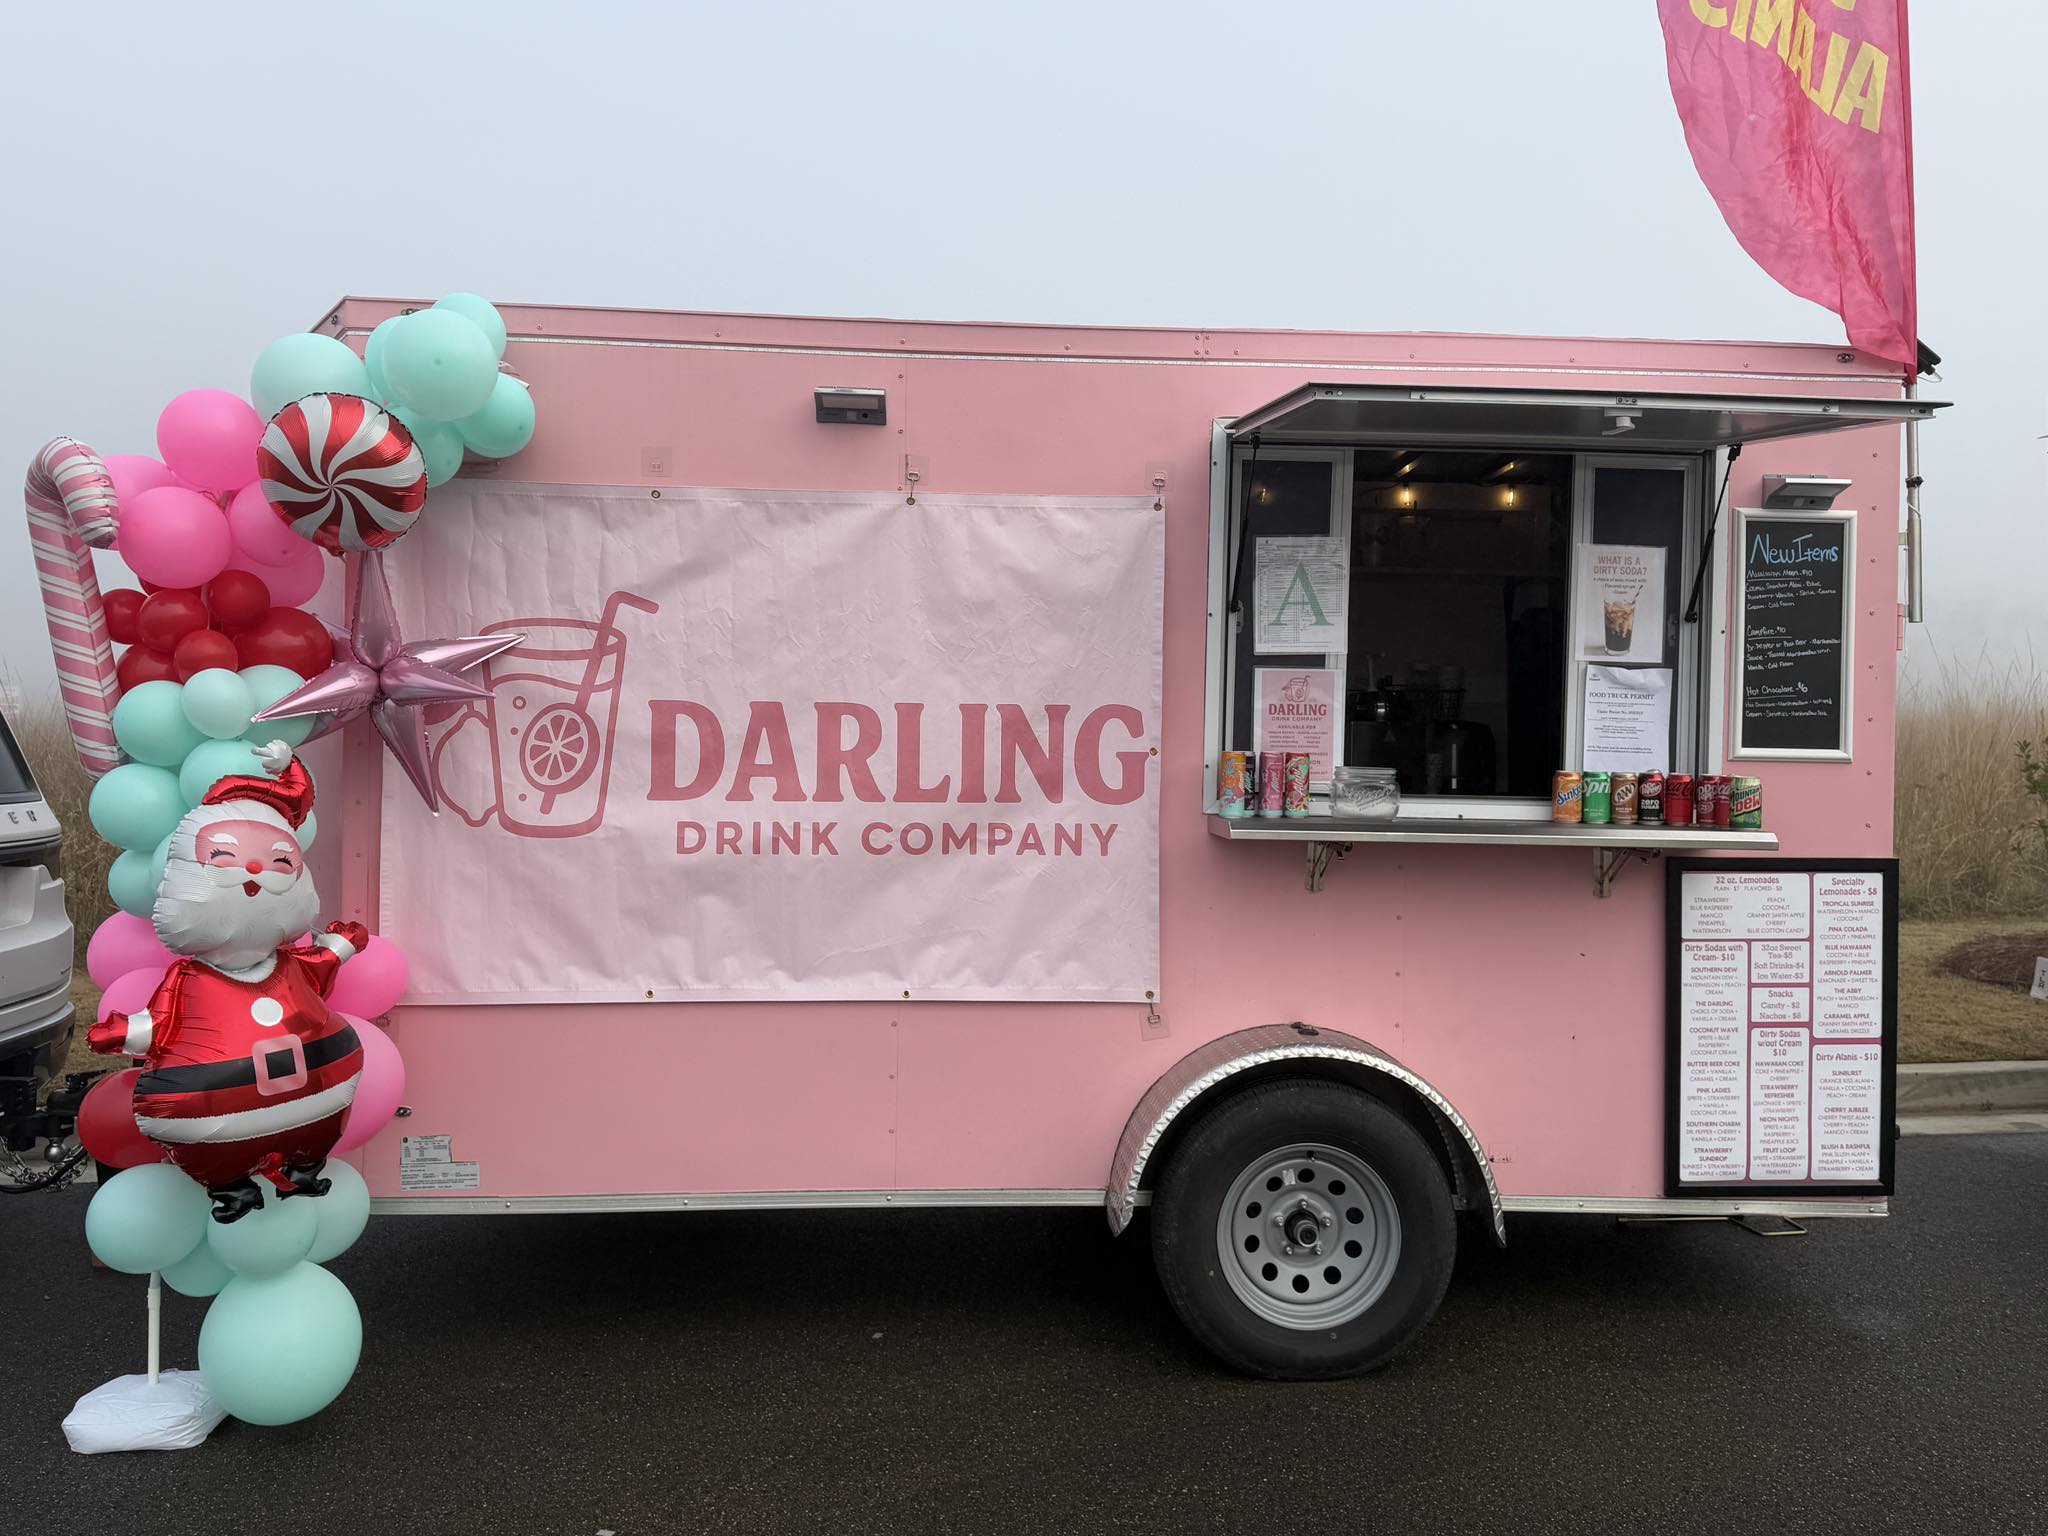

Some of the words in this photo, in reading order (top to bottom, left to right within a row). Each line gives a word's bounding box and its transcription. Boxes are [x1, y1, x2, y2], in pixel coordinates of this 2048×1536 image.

[1599, 556, 1622, 564] WHAT
[1625, 557, 1632, 565] IS
[1635, 557, 1640, 565] A
[1594, 566, 1617, 574] DIRTY
[1620, 567, 1647, 575] SODA?
[1268, 560, 1334, 626] A
[1269, 704, 1327, 716] DARLING
[646, 699, 1150, 806] DARLING
[675, 821, 840, 857] DRINK
[860, 821, 1119, 857] COMPANY
[1832, 878, 1865, 886] Specialty
[1685, 944, 1703, 952] Dirty
[1704, 944, 1726, 952] Sodas
[1728, 944, 1743, 952] with
[1761, 1002, 1785, 1010] Candy
[1791, 1001, 1800, 1009] $2
[1760, 1030, 1777, 1038] Dirty
[1779, 1030, 1800, 1038] Sodas
[1816, 1053, 1834, 1061] Dirty
[1836, 1053, 1857, 1061] Alanis
